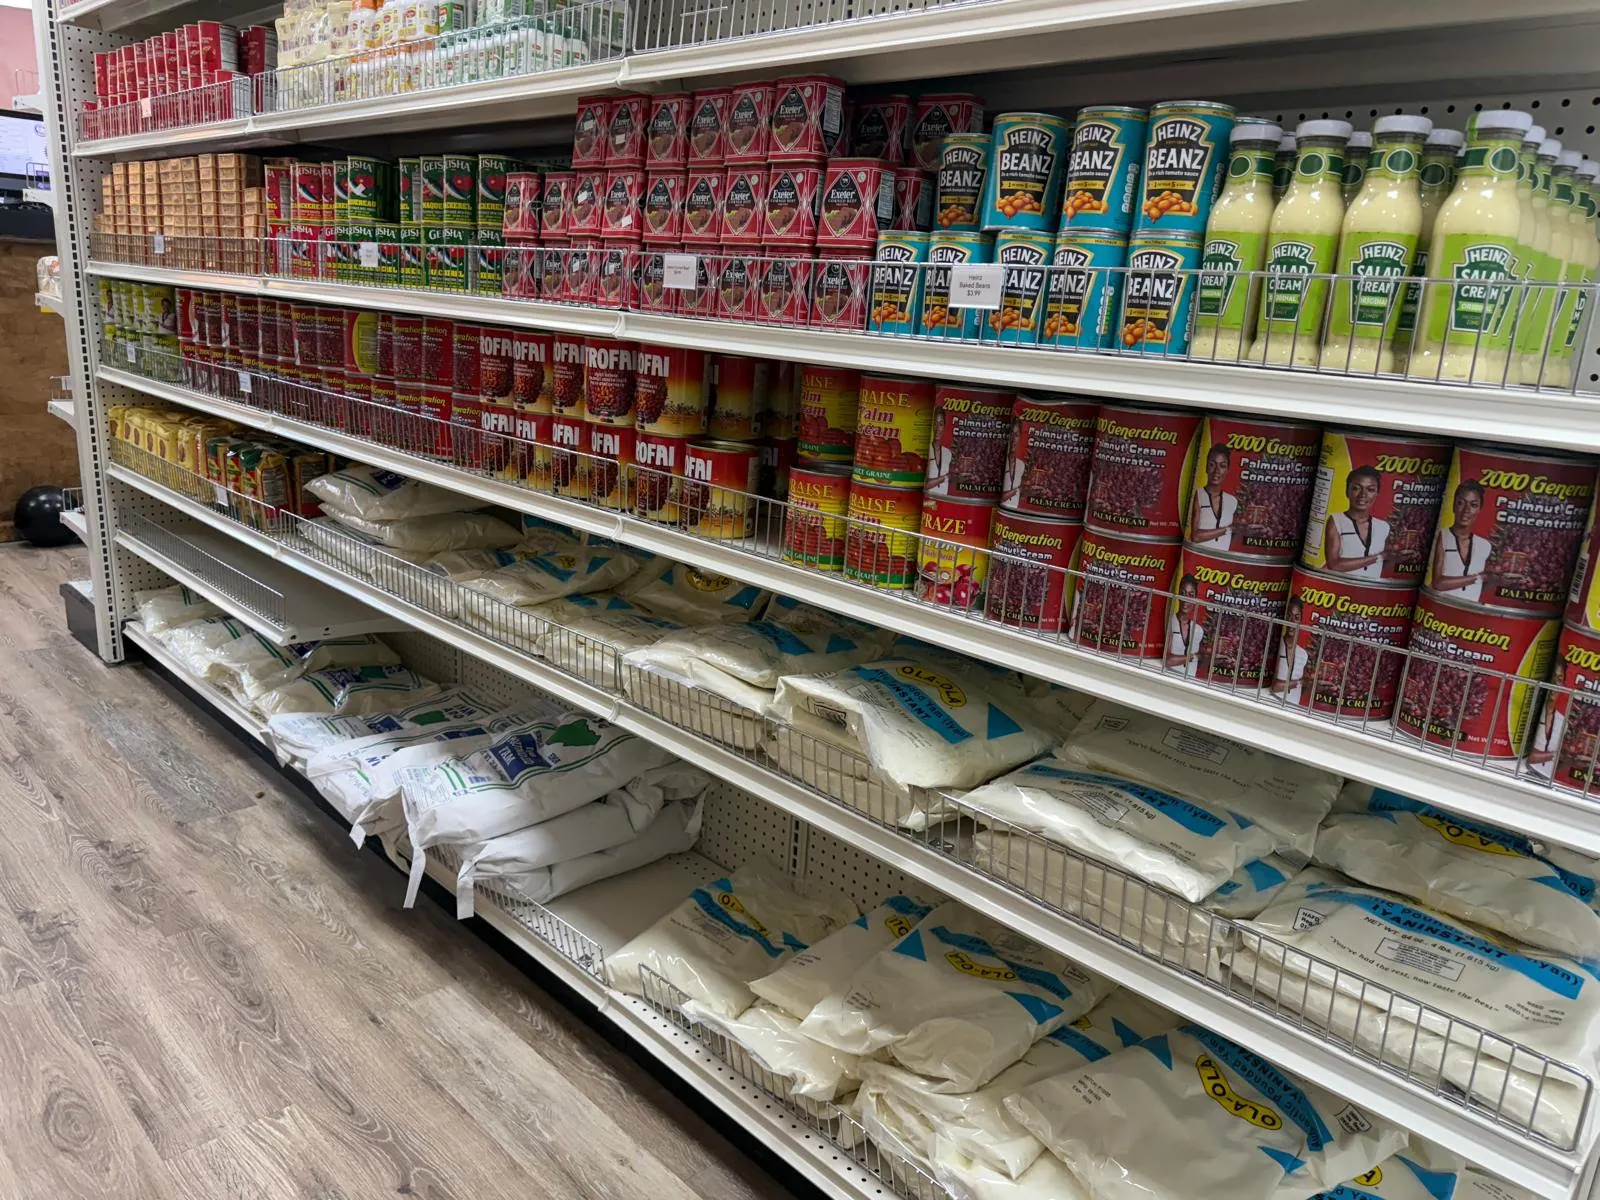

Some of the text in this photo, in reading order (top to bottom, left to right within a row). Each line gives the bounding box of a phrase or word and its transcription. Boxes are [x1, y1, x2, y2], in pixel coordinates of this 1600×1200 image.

[780, 104, 803, 115] Exeter
[1010, 127, 1049, 148] HEINZ
[1077, 127, 1112, 144] HEINZ
[1158, 123, 1201, 142] HEINZ
[423, 160, 443, 172] GEIS
[946, 150, 978, 164] HEINZ
[1001, 153, 1051, 174] BEANZ
[1070, 150, 1115, 170] BEANZ
[1150, 148, 1204, 169] BEANZ
[941, 170, 981, 187] BEANZ
[731, 192, 750, 201] Exeter
[773, 189, 795, 199] Exeter
[831, 189, 856, 199] Exeter
[880, 249, 911, 262] HEINZ
[932, 250, 964, 264] HEINZ
[1003, 249, 1040, 265] HEINZ
[1206, 242, 1233, 256] HEINZ
[1274, 245, 1309, 259] HEINZ
[1364, 247, 1403, 261] HEINZ
[1470, 248, 1509, 265] HEINZ
[1054, 252, 1084, 266] HEINZ
[1134, 254, 1175, 269] HEINZ
[875, 267, 912, 285] BEANZ
[1005, 269, 1042, 289] EANZ
[1357, 264, 1401, 277] SALAD
[1269, 279, 1302, 291] CREAM
[1461, 285, 1498, 299] CREAM
[513, 341, 545, 362] OFAI
[553, 341, 585, 364] OFAI
[639, 352, 670, 378] OFAI
[862, 388, 911, 408] RAISE
[943, 397, 1011, 418] 2000 Genera
[952, 417, 991, 428] Palmnut
[1019, 408, 1096, 429] 2000 Generat
[516, 419, 537, 440] FAI
[552, 423, 579, 446] OFAI
[953, 427, 1010, 439] Concentrat
[1028, 427, 1069, 440] Palmnut
[1108, 420, 1178, 444] Generation
[592, 431, 620, 455] OFAI
[1130, 444, 1166, 457] Cream
[1226, 433, 1316, 459] 2000 Generat
[685, 455, 712, 481] OFAI
[1241, 457, 1291, 471] Palmnut
[1375, 454, 1419, 473] 2000
[1241, 471, 1309, 485] Concentrat
[1479, 468, 1592, 501] 2000 Genera
[790, 479, 833, 498] RAISE
[959, 484, 982, 492] PALM
[851, 493, 897, 514] RAISE
[1030, 498, 1053, 507] PALM
[1496, 496, 1561, 514] Palmnut
[1113, 515, 1146, 526] CREAM
[1496, 512, 1584, 530] Concentrat
[1002, 525, 1062, 550] Generation
[1246, 537, 1274, 546] PALM
[1020, 546, 1052, 560] Cream
[1095, 546, 1165, 571] Generation
[1119, 570, 1155, 582] Cream
[1194, 566, 1290, 594] 2000 Generati
[1206, 590, 1256, 605] Palmnut
[1301, 587, 1335, 608] 2000
[1501, 586, 1534, 599] PALM
[1311, 612, 1403, 633] Palmnut Cream
[1424, 613, 1510, 650] Generation
[1447, 644, 1494, 663] Cream
[902, 666, 961, 703] OLA-OLA
[1400, 713, 1421, 727] PALM
[1371, 903, 1509, 959] IYANINSTANT
[1364, 916, 1382, 927] NET
[1485, 963, 1500, 973] kg)
[1358, 953, 1375, 965] had
[1376, 962, 1389, 972] the
[1391, 969, 1411, 980] rest,
[1412, 976, 1431, 985] now
[1432, 982, 1455, 993] taste
[1457, 991, 1472, 1000] the
[1232, 1061, 1282, 1102] Pounded
[1200, 1059, 1277, 1127] OLA-OLA
